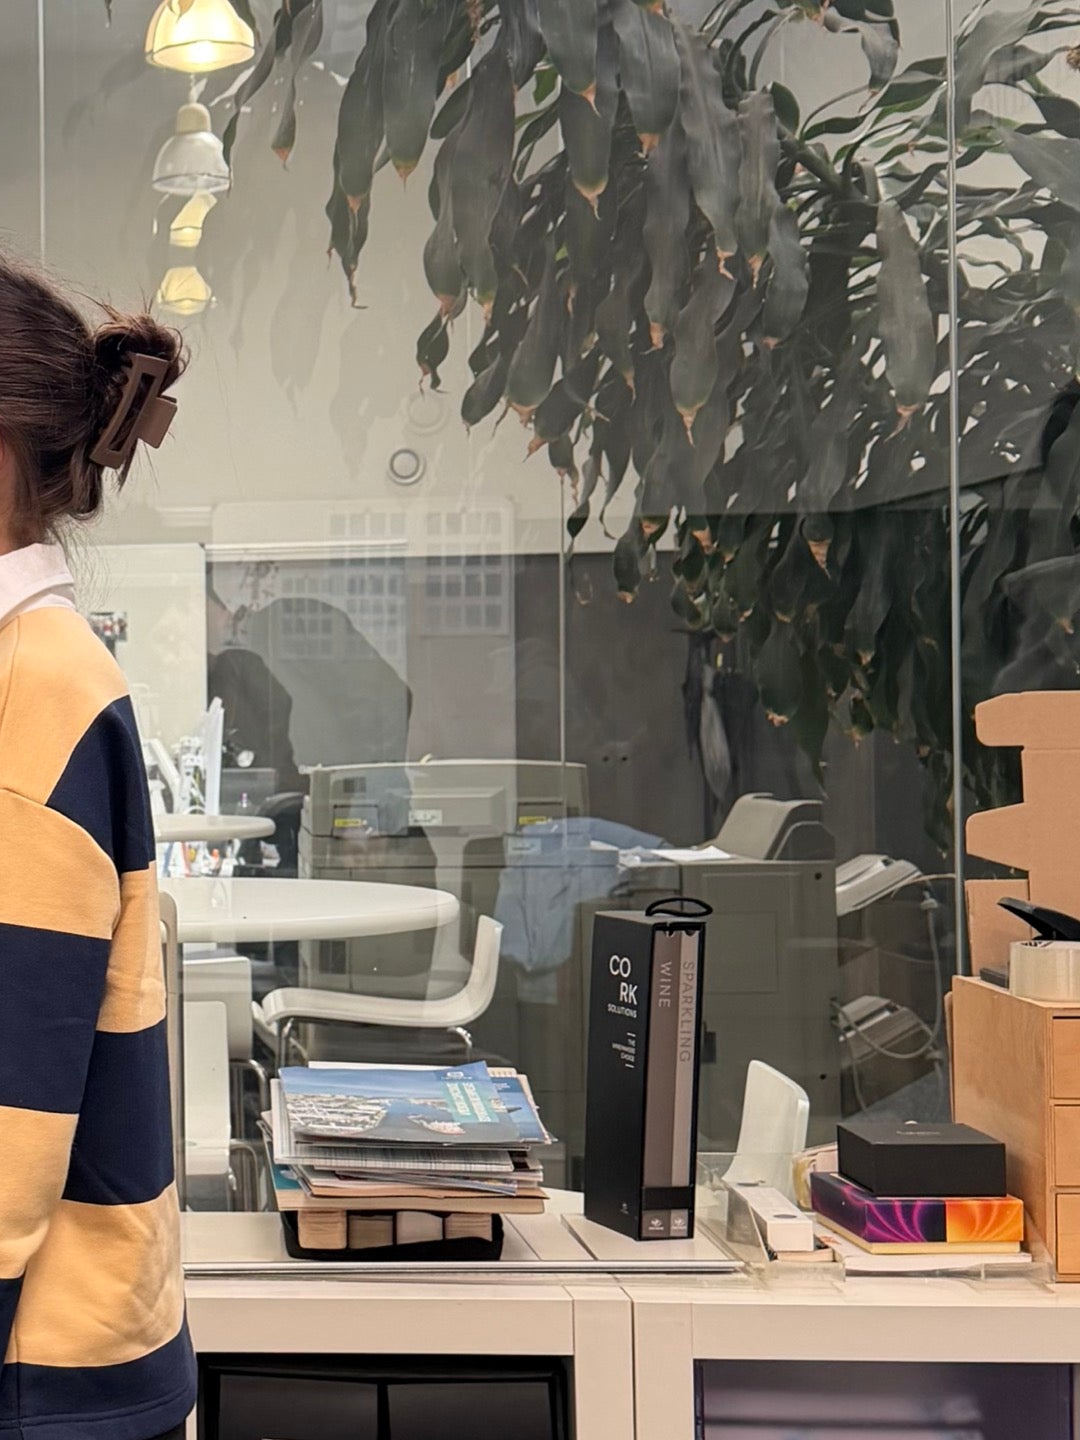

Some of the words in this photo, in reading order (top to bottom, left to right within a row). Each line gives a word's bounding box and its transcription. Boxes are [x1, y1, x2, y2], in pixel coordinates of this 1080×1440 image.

[609, 954, 632, 978] CO
[619, 981, 638, 1006] RK
[658, 961, 672, 1008] WINE
[607, 1003, 637, 1018] SOLUTIONS
[679, 960, 695, 1063] SPARKLING
